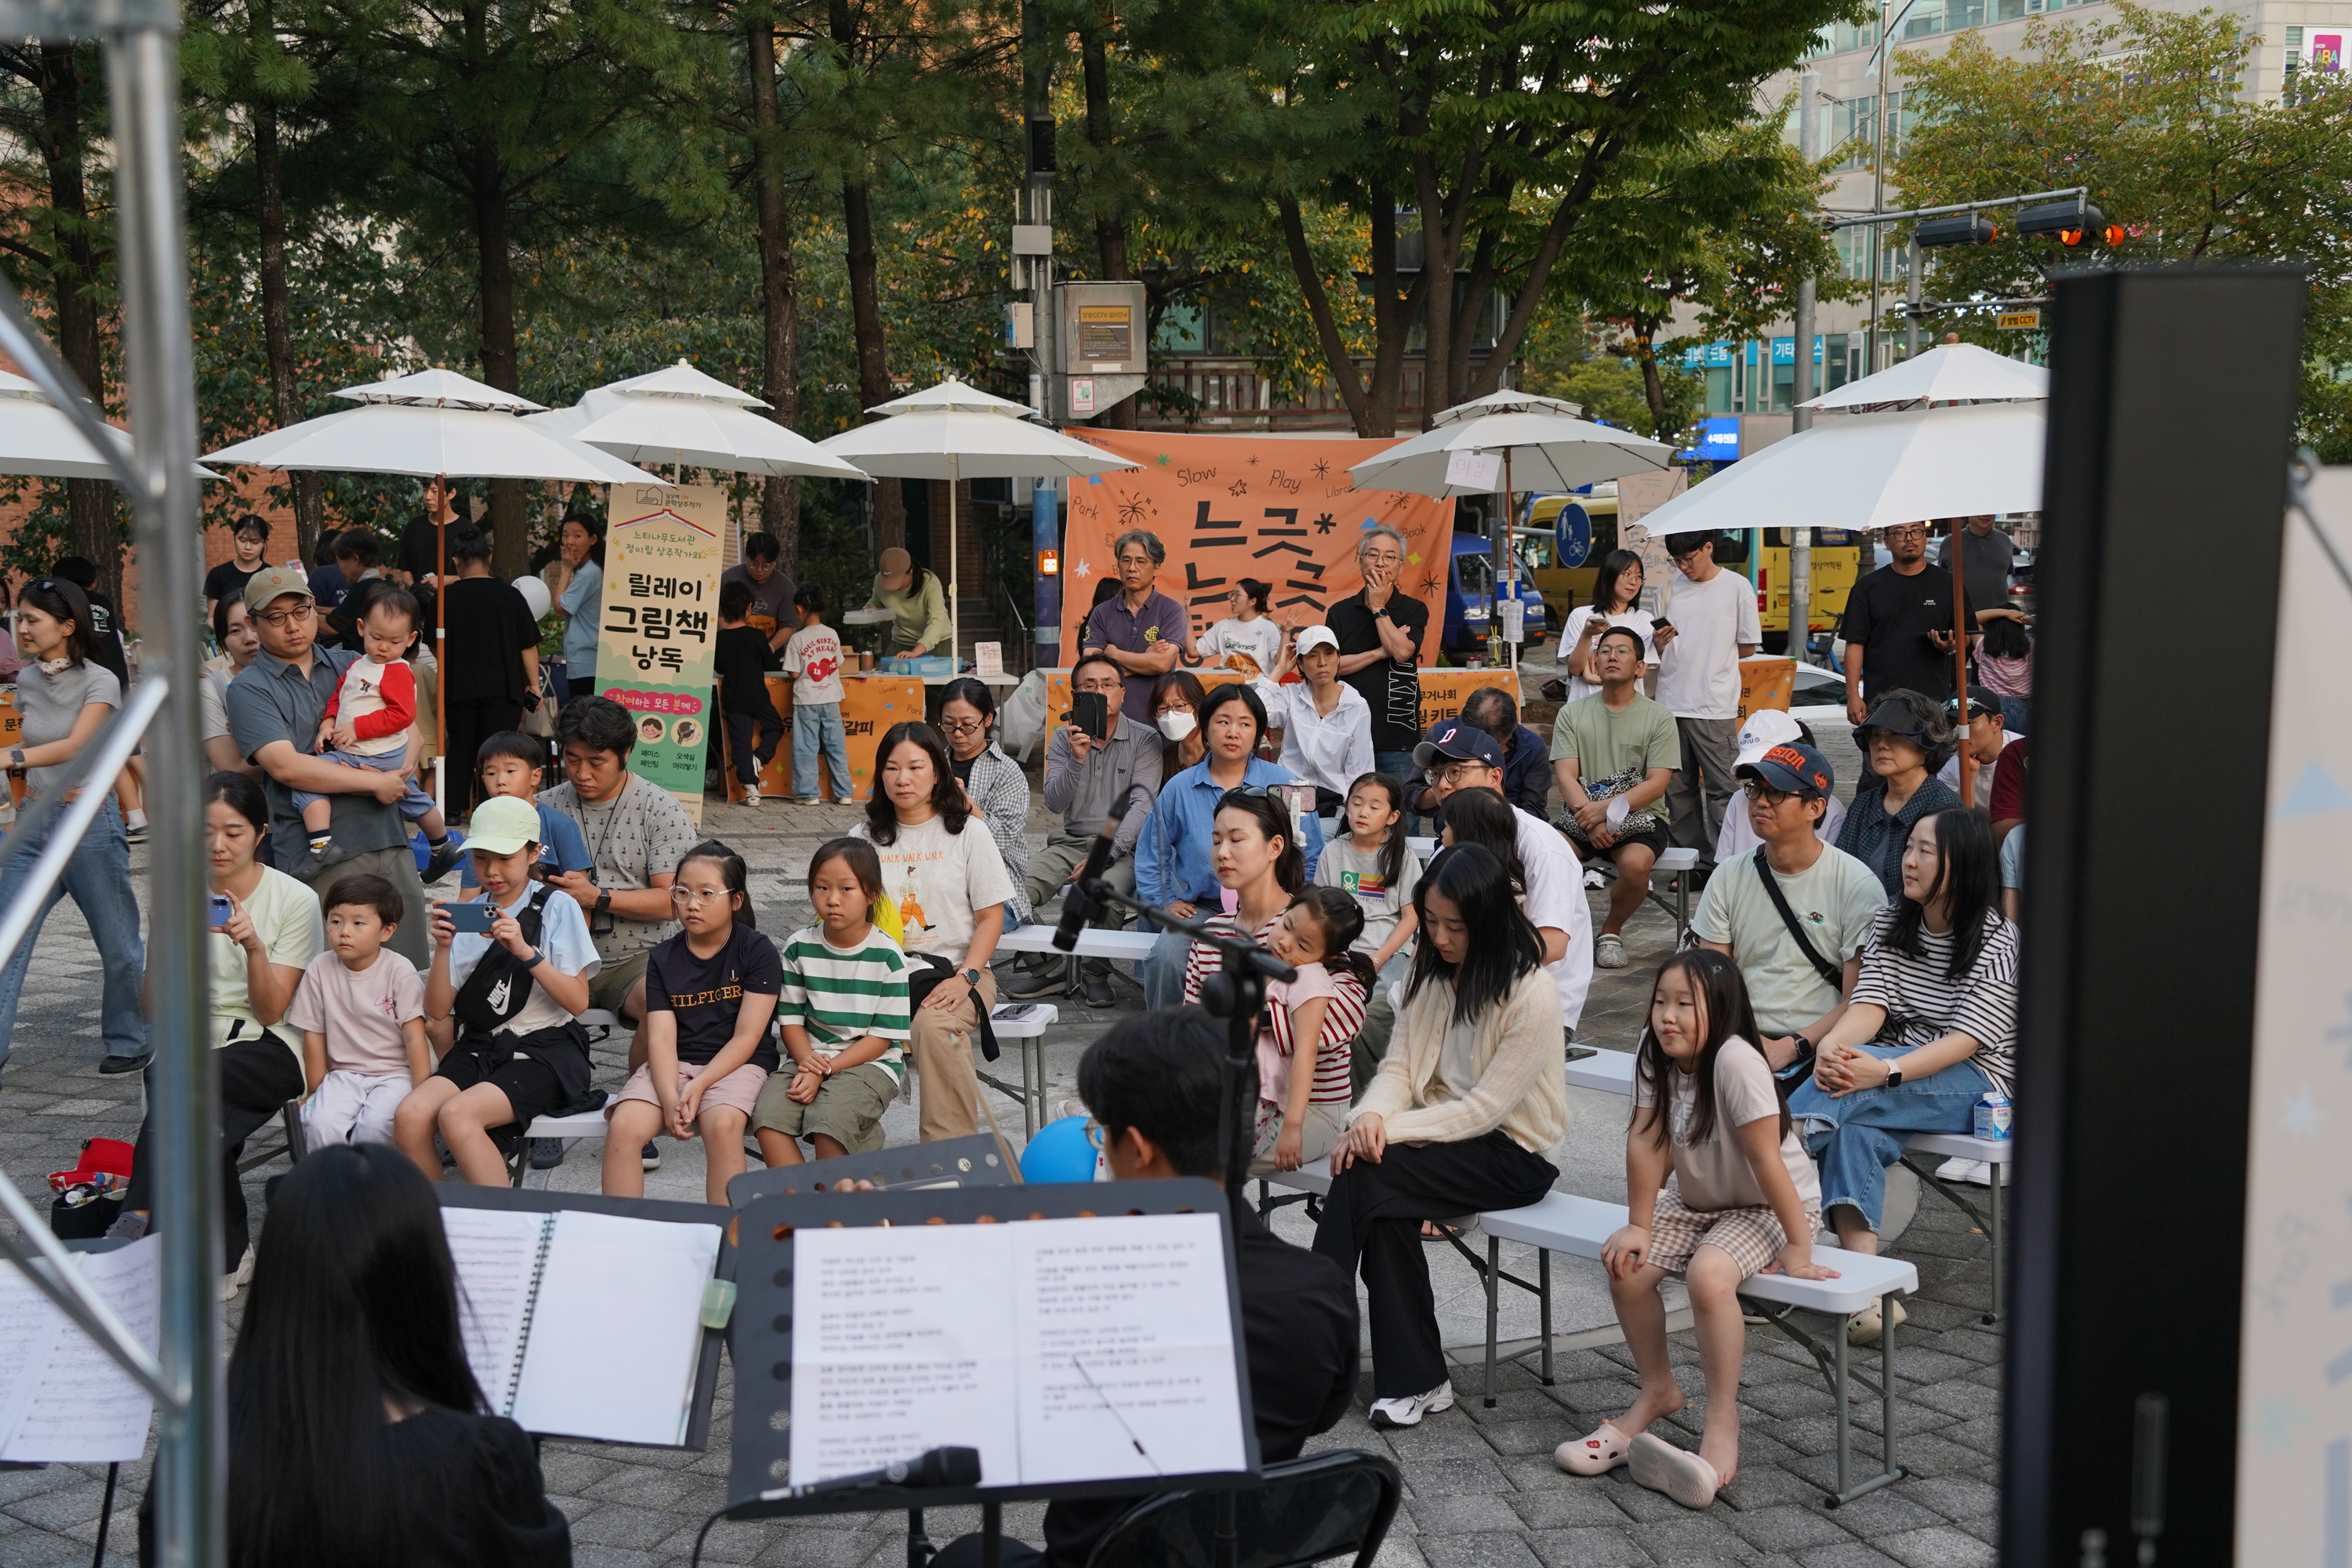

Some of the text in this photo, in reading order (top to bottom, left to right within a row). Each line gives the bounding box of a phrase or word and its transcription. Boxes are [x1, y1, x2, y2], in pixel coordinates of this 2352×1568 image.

[2314, 49, 2339, 64] ABA
[2007, 315, 2036, 326] 방범 CCTV
[1091, 437, 1109, 446] 경기도
[1456, 459, 1486, 478] 마감
[1177, 467, 1216, 487] Slow
[1269, 469, 1301, 495] Play
[665, 499, 702, 509] 문학상주작가
[1072, 495, 1099, 521] Park
[633, 531, 696, 546] 느티나무도서관
[1401, 524, 1427, 539] Book
[626, 543, 653, 555] 정이립
[629, 572, 702, 601] 릴레이
[604, 605, 708, 644] 그림책
[800, 641, 816, 657] SOUL
[807, 650, 815, 660] AT
[632, 644, 684, 673] 낭독
[879, 686, 897, 695] Library
[1420, 689, 1457, 702] 무거나회
[615, 693, 691, 711] 참여하는 모든 분께
[906, 704, 924, 716] Park
[1438, 728, 1458, 744] D
[641, 750, 660, 758] 페이스
[676, 753, 695, 761] 오색실
[640, 760, 659, 768] 페인팅
[673, 762, 698, 771] 머리땋기
[880, 850, 944, 863] WALK WALK WALK
[487, 978, 507, 1008] NIKE
